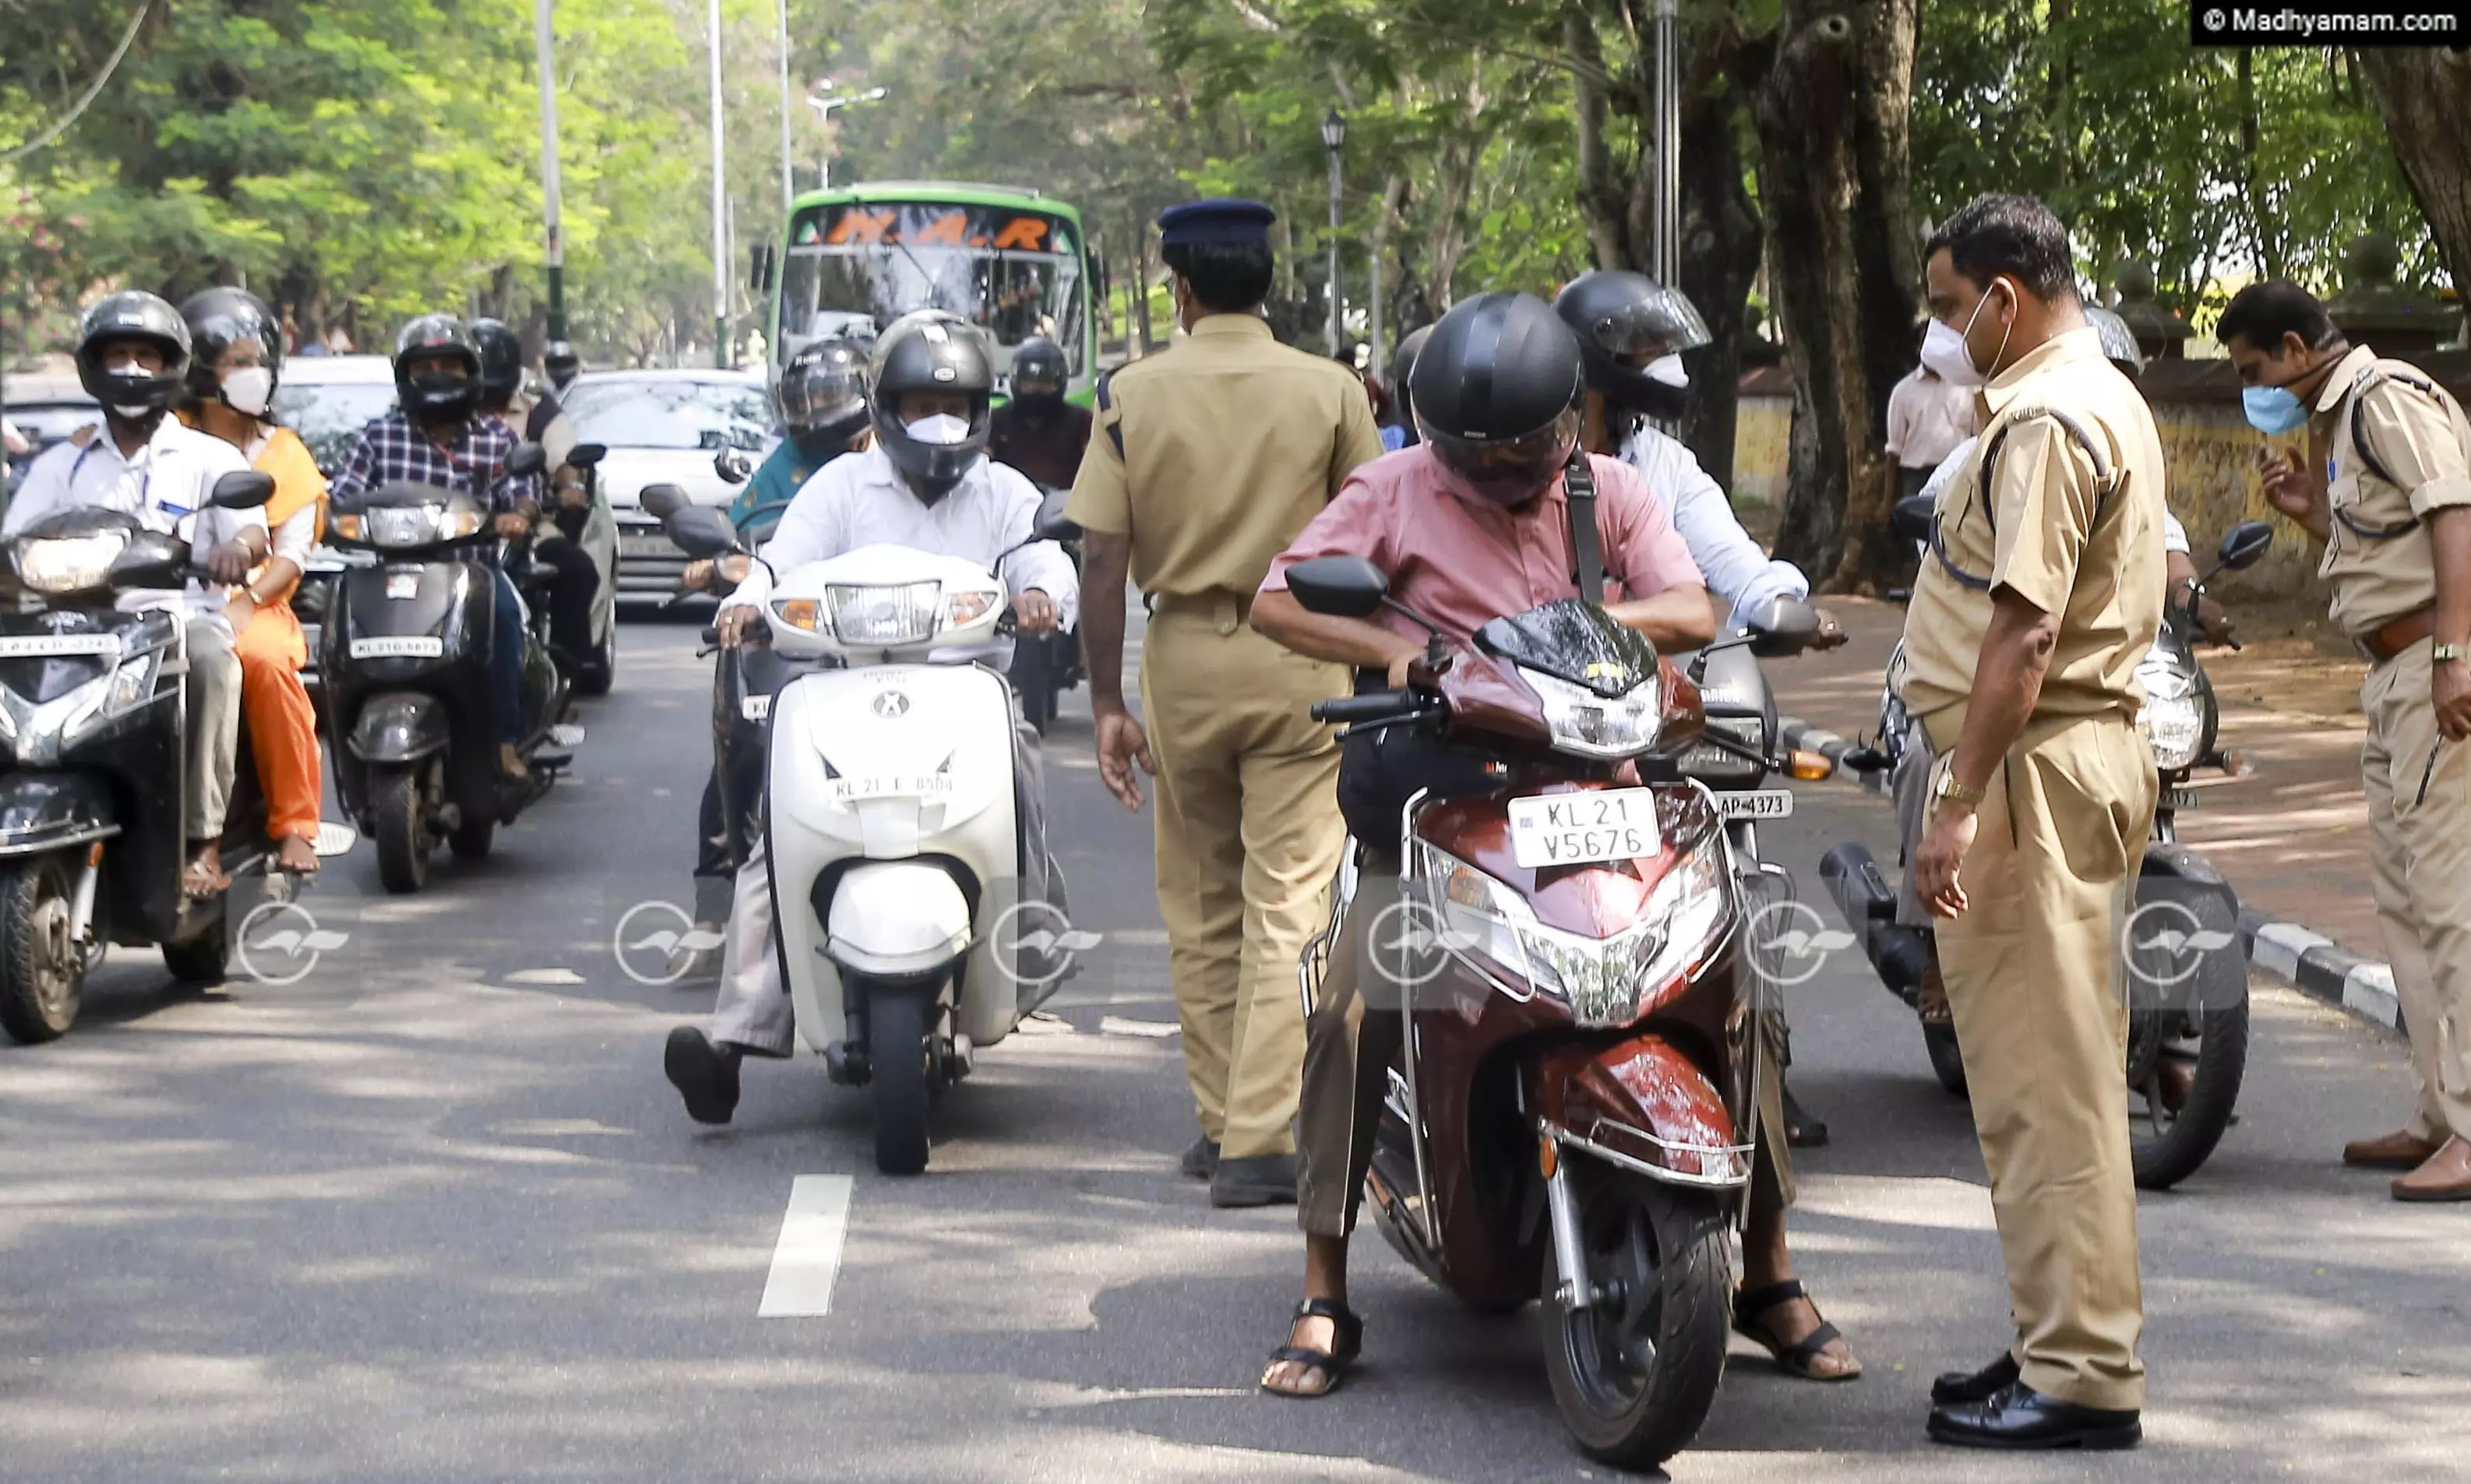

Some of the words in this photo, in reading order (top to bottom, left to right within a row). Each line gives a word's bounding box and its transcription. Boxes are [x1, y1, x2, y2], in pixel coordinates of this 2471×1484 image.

[837, 781, 855, 796] KL
[864, 777, 879, 792] 21
[1548, 802, 1586, 828] KL
[1594, 798, 1627, 824] 21
[1544, 828, 1641, 860] V5676
